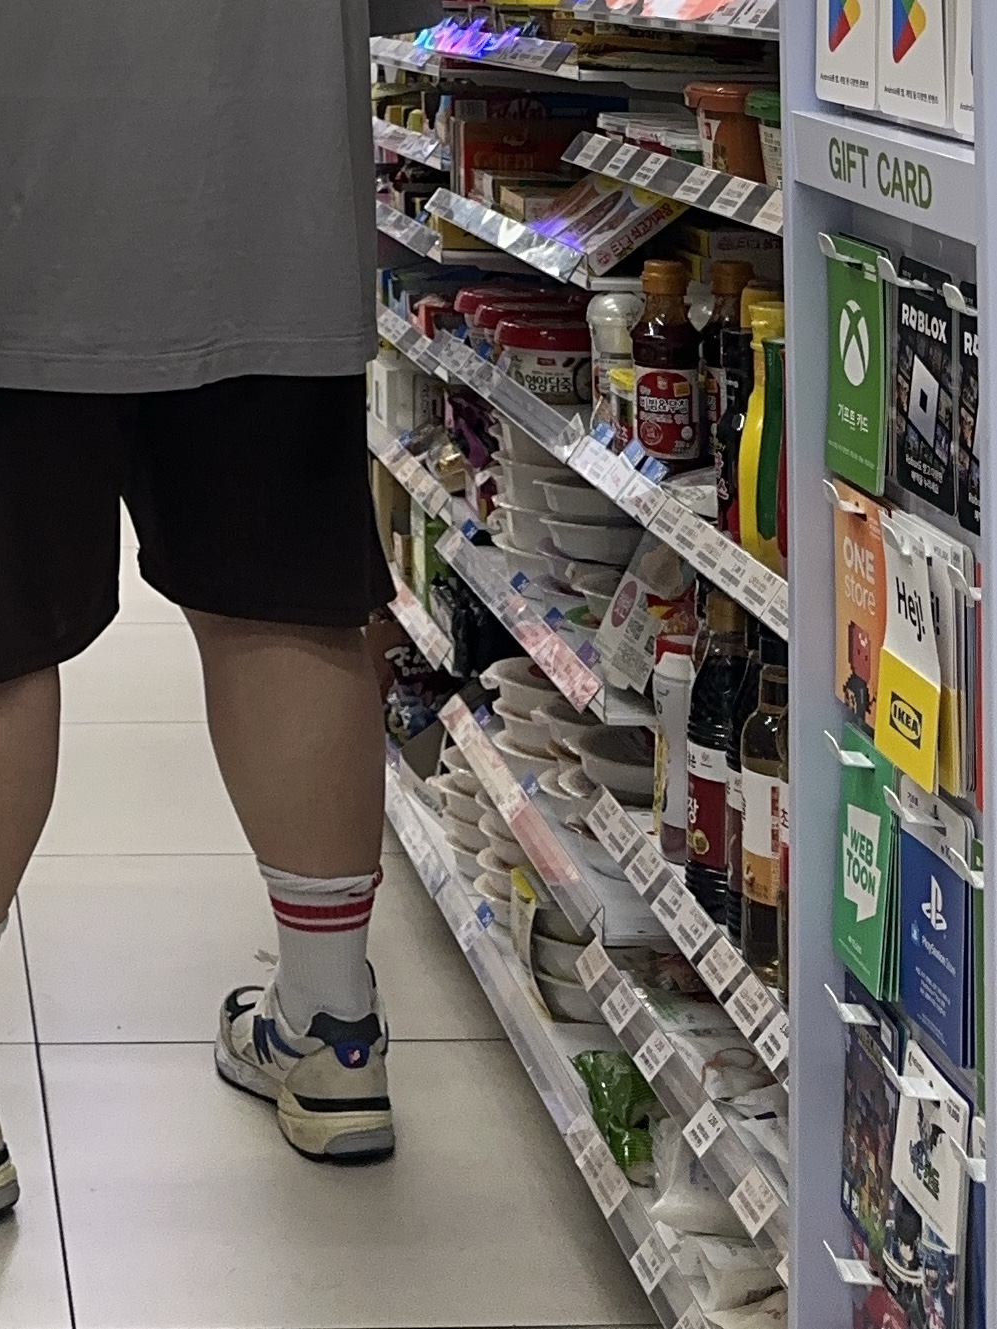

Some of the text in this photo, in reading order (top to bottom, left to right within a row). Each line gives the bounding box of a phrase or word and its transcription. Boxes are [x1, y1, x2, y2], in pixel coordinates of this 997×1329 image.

[828, 136, 932, 210] GIFT CARD
[901, 302, 947, 345] ROBLOX
[842, 534, 876, 587] ONE
[844, 574, 877, 616] store
[895, 576, 926, 642] Hej!
[893, 703, 920, 735] IKEA
[850, 825, 874, 868] WEB
[846, 851, 877, 898] TOON
